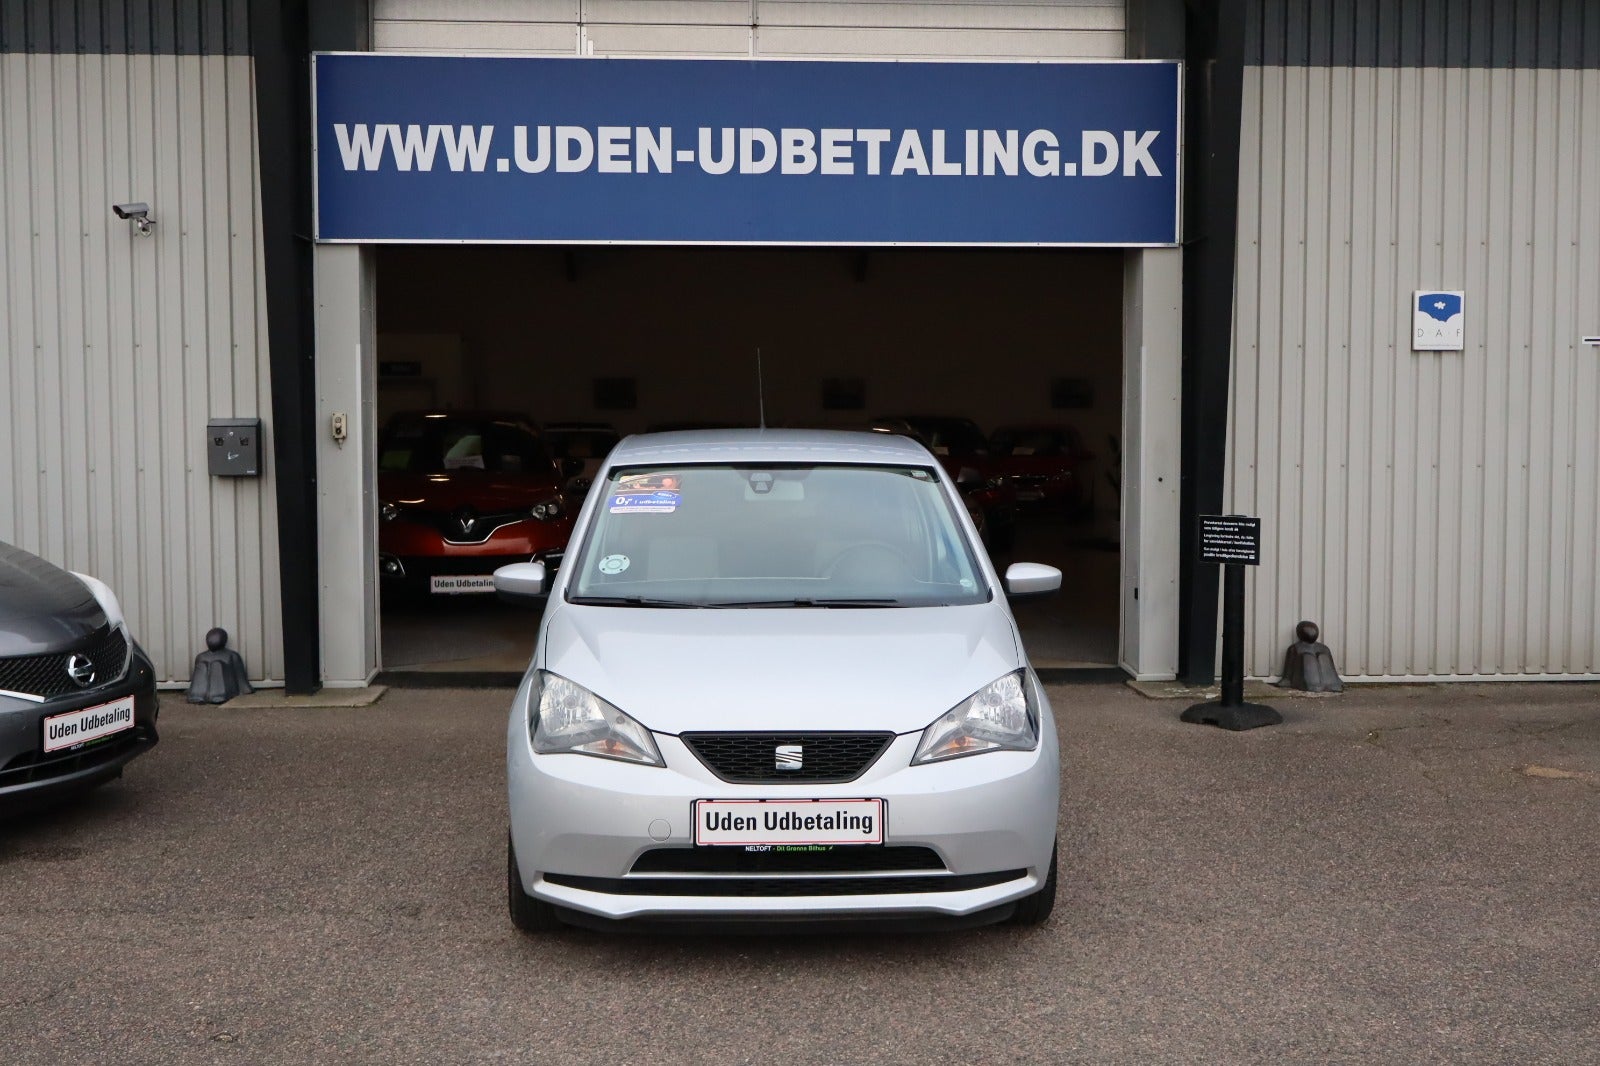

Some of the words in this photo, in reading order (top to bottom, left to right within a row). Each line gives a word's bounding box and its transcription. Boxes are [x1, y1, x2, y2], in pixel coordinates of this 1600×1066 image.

[334, 124, 1162, 177] WWW.UDEN-UDBETALING.DK
[434, 580, 455, 588] Uden
[456, 579, 496, 588] Udbetalin
[50, 722, 77, 740] Uden
[81, 708, 130, 732] Udbetaling
[706, 811, 757, 831] Uden
[764, 810, 873, 835] Udbetaling
